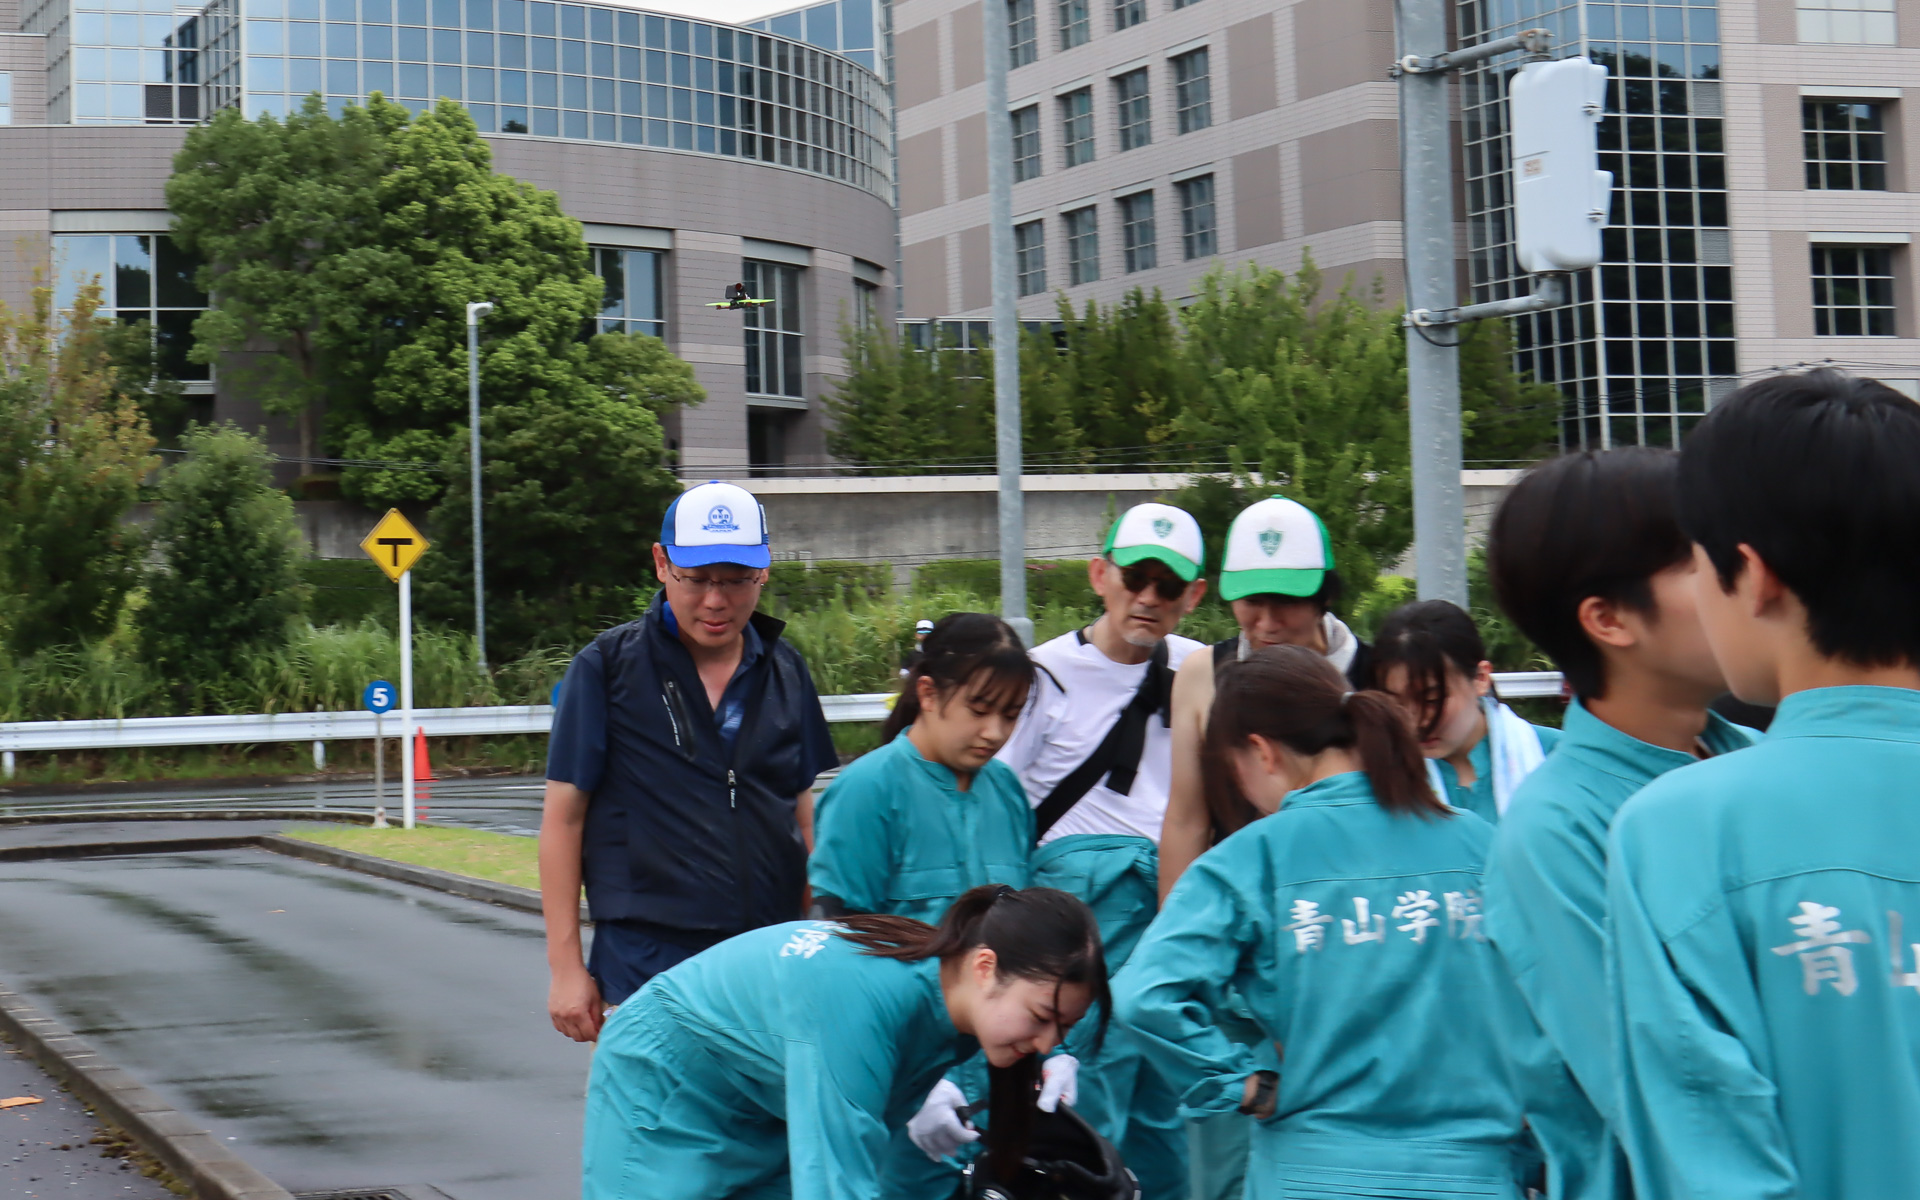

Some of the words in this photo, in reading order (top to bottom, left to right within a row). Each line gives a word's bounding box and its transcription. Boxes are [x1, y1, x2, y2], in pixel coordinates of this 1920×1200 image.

[372, 687, 388, 707] 5
[1282, 890, 1487, 953] 青山学院
